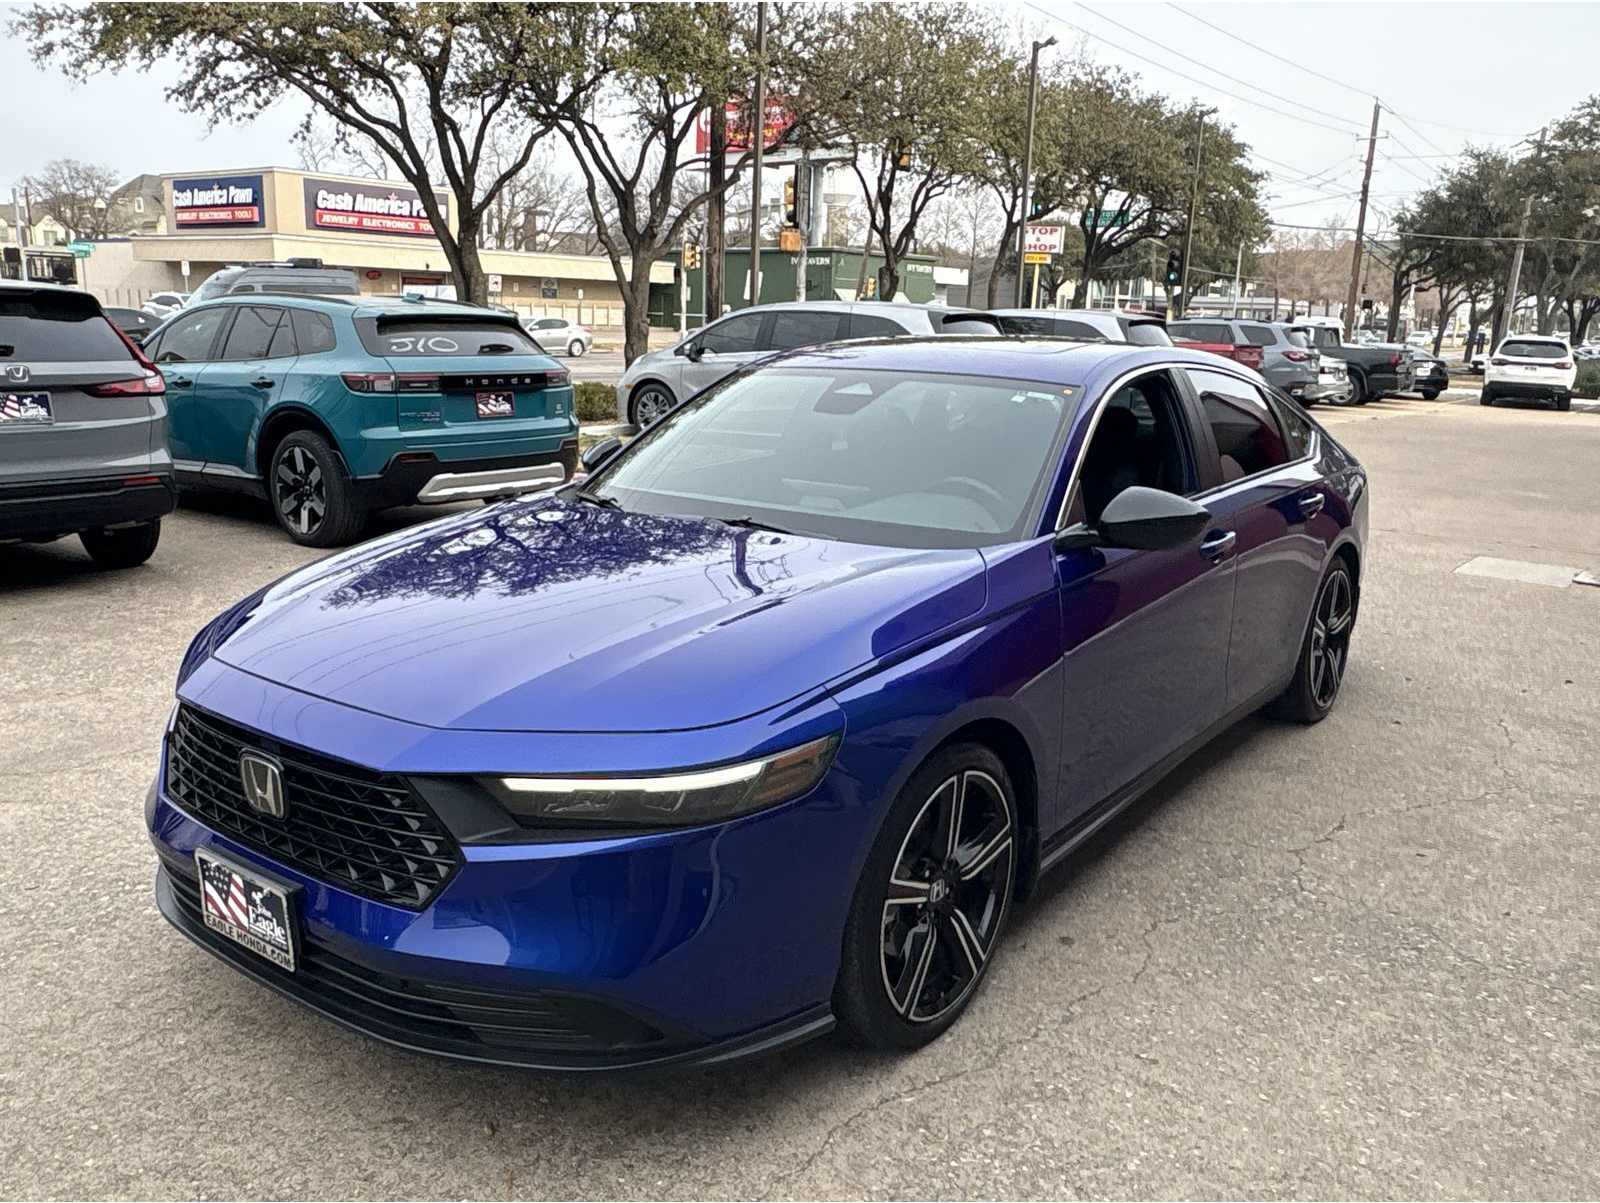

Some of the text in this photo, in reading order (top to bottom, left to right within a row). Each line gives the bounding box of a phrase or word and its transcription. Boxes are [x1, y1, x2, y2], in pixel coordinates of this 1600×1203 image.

[172, 185, 253, 207] Cash America Pawn
[316, 189, 354, 211] Cash
[354, 193, 411, 217] America
[321, 213, 360, 225] JEWELRY
[362, 217, 416, 231] ELECTRONICS
[1024, 243, 1057, 251] HOP
[807, 256, 830, 265] AVERN
[206, 914, 235, 938] EAGLE
